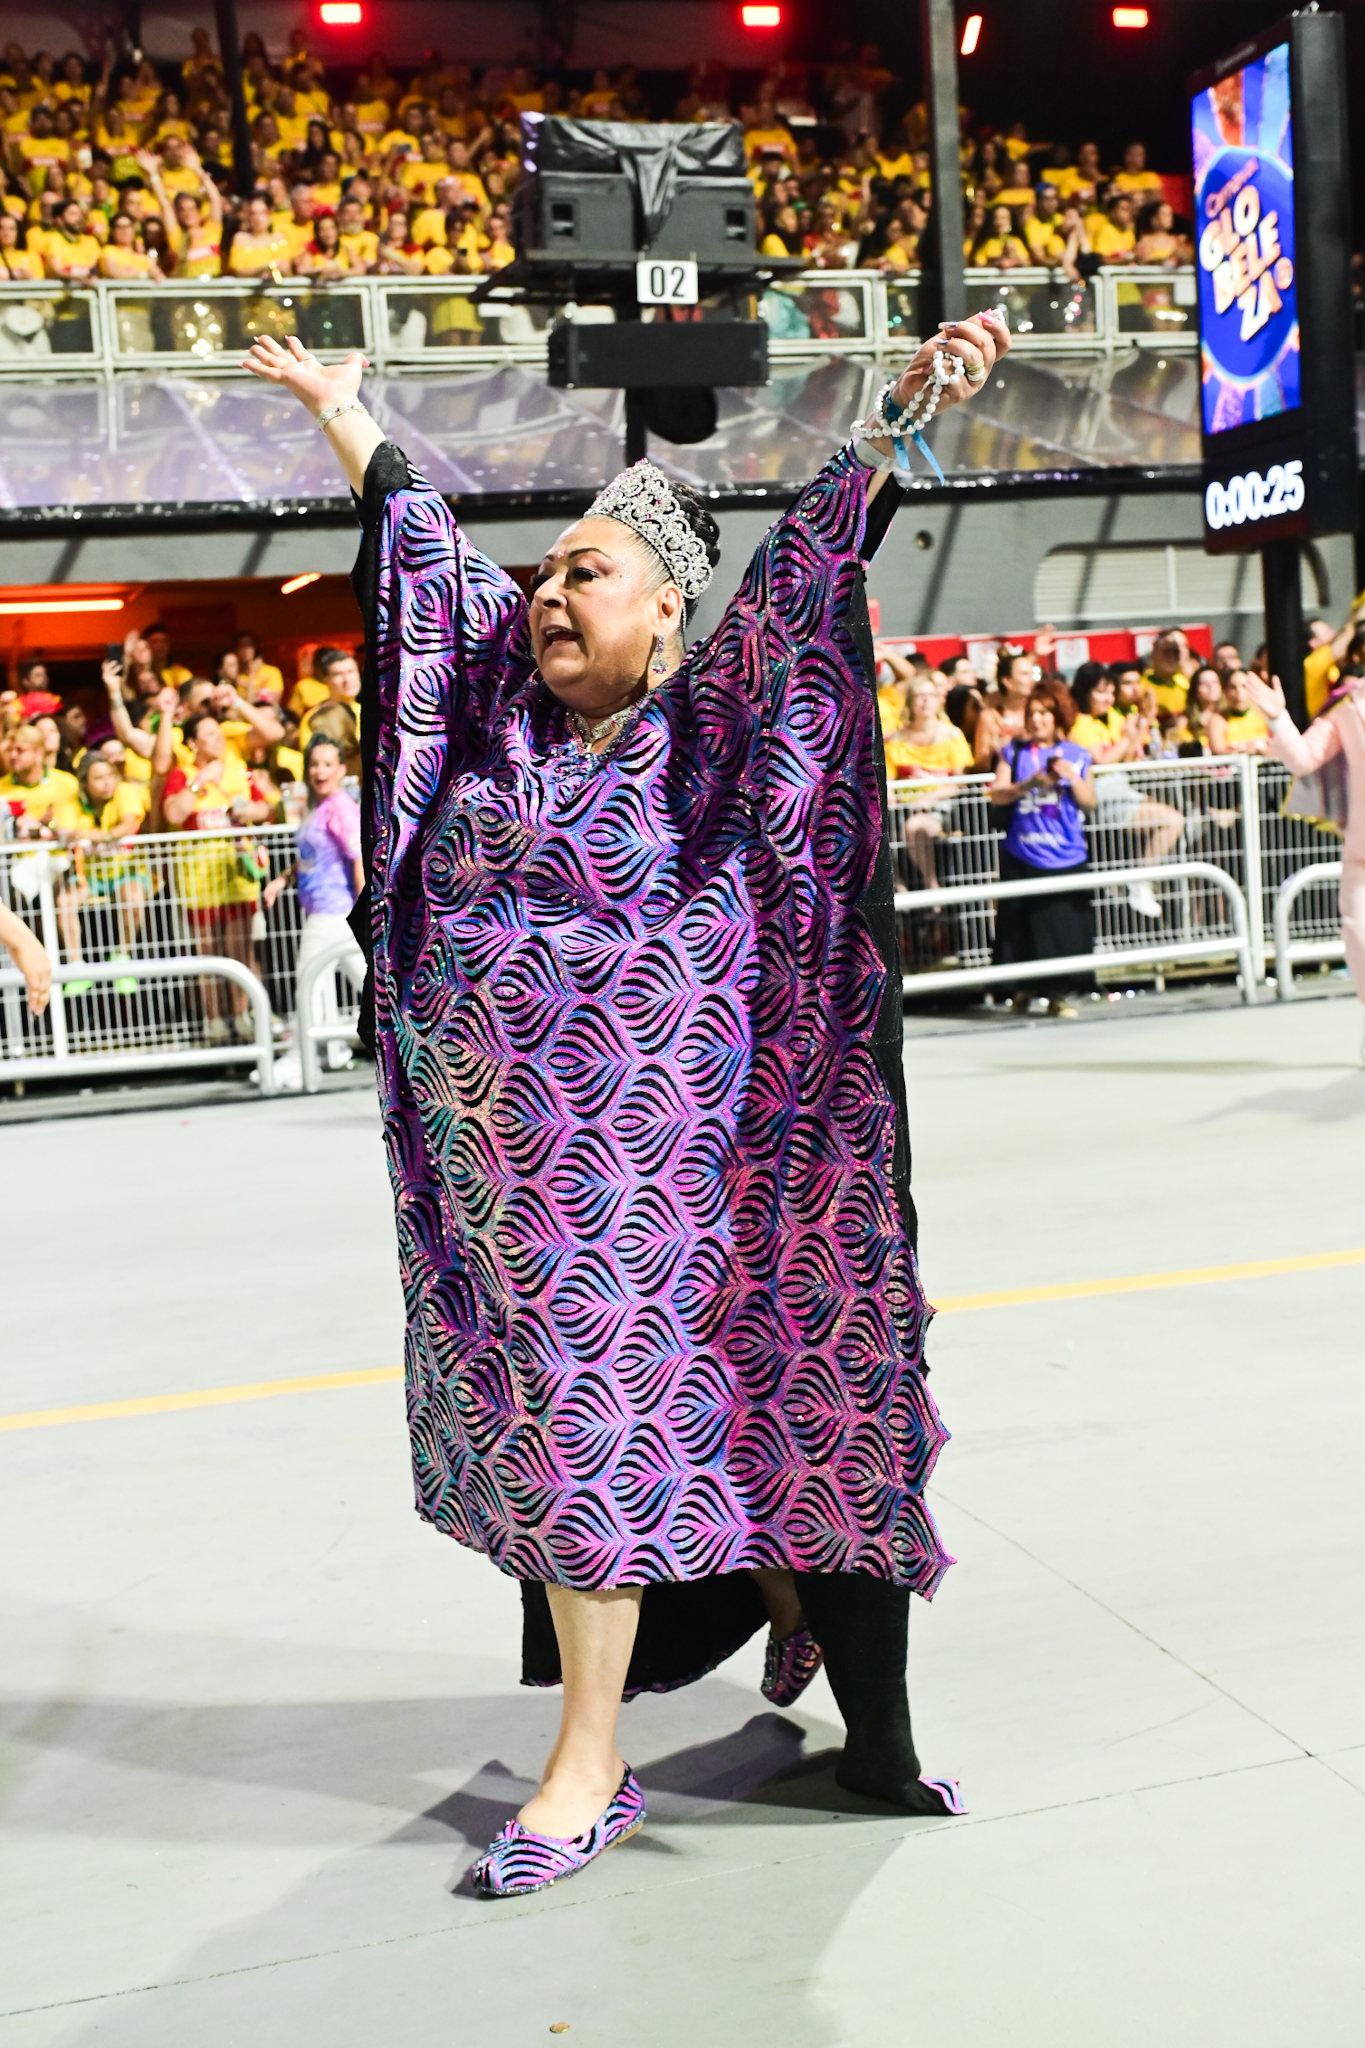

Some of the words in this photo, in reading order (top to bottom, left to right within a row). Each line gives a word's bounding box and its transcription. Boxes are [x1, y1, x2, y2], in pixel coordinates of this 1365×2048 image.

[1199, 185, 1260, 271] GLO
[1213, 210, 1281, 314] BELE
[650, 266, 684, 297] 02
[1237, 270, 1283, 341] ZA
[1205, 460, 1305, 530] 0:00:25
